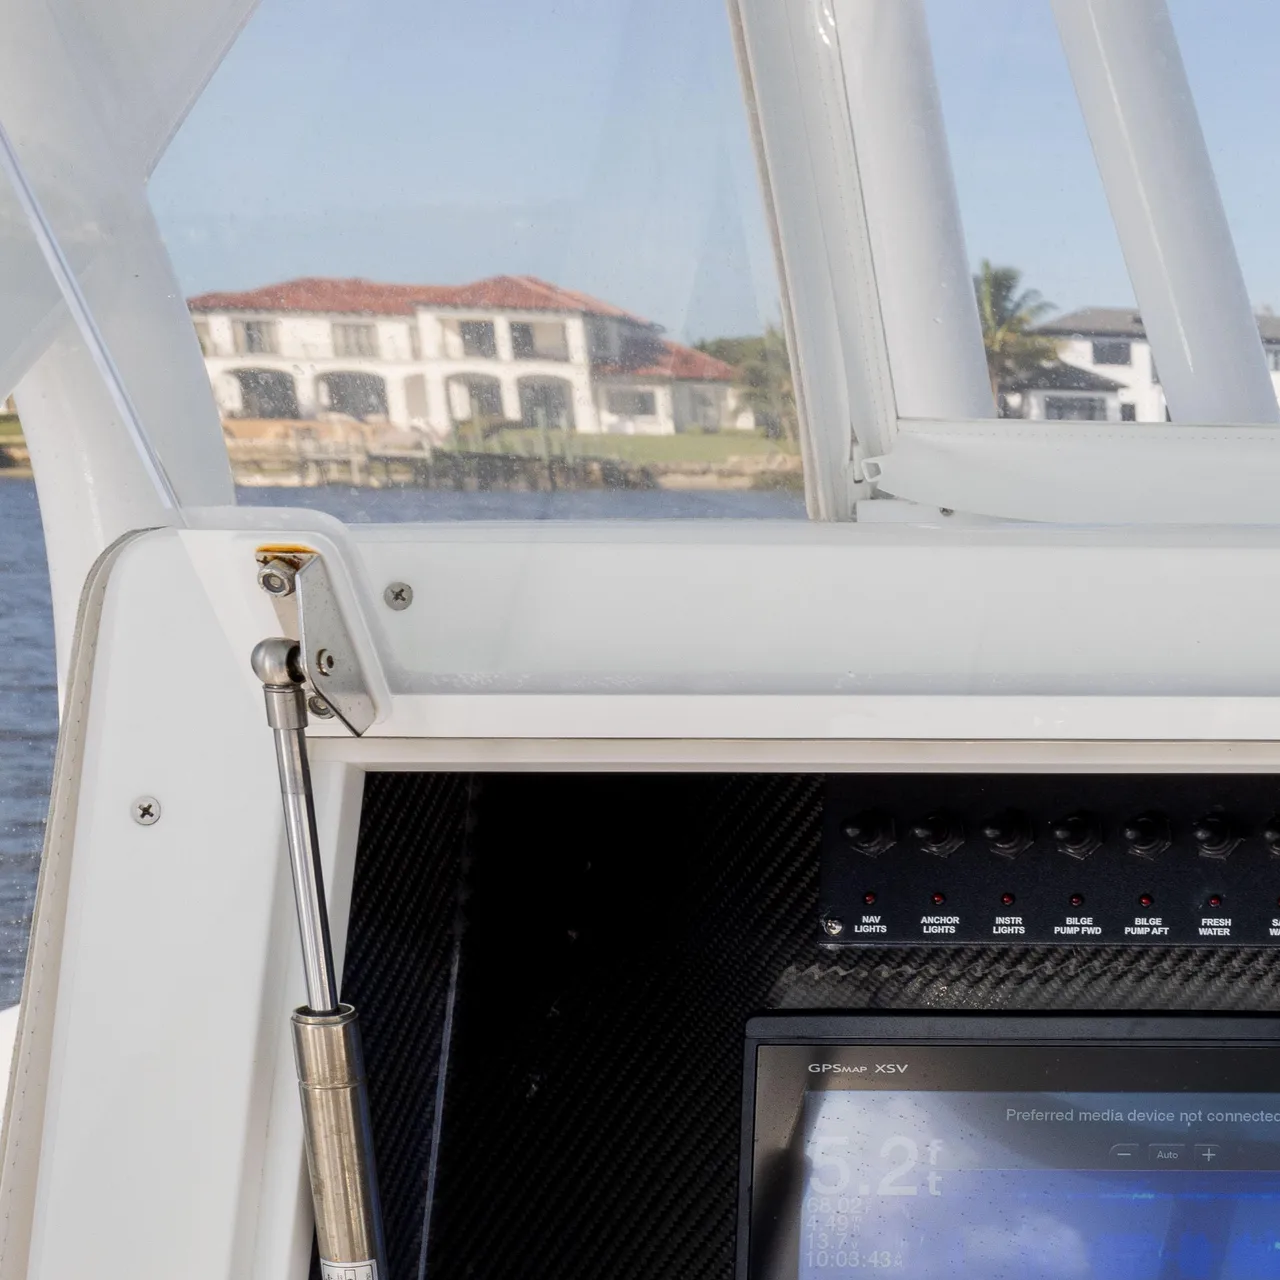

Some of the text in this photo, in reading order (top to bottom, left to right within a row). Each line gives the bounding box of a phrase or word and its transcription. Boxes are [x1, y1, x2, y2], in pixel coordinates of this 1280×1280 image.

[862, 916, 881, 926] NAV
[921, 916, 959, 924] ANCHOR
[996, 917, 1023, 927] INSTR
[1066, 917, 1093, 925] BILGE
[1135, 918, 1164, 928] BILGE
[1202, 918, 1231, 926] FRESH
[855, 925, 887, 933] LIGHTS
[993, 926, 1025, 934] LIGHTS
[1151, 927, 1169, 935] AFT
[807, 1063, 909, 1074] GPSMAP XSV
[1006, 1108, 1074, 1122] Preferred
[1079, 1109, 1124, 1122] media
[1127, 1109, 1175, 1122] device
[1179, 1110, 1203, 1123] not
[1157, 1151, 1179, 1160] Auto
[807, 1135, 919, 1196] 5.2
[806, 1215, 849, 1232] 4.49
[806, 1233, 849, 1249] 13.7
[806, 1251, 891, 1268] 10:03:43
